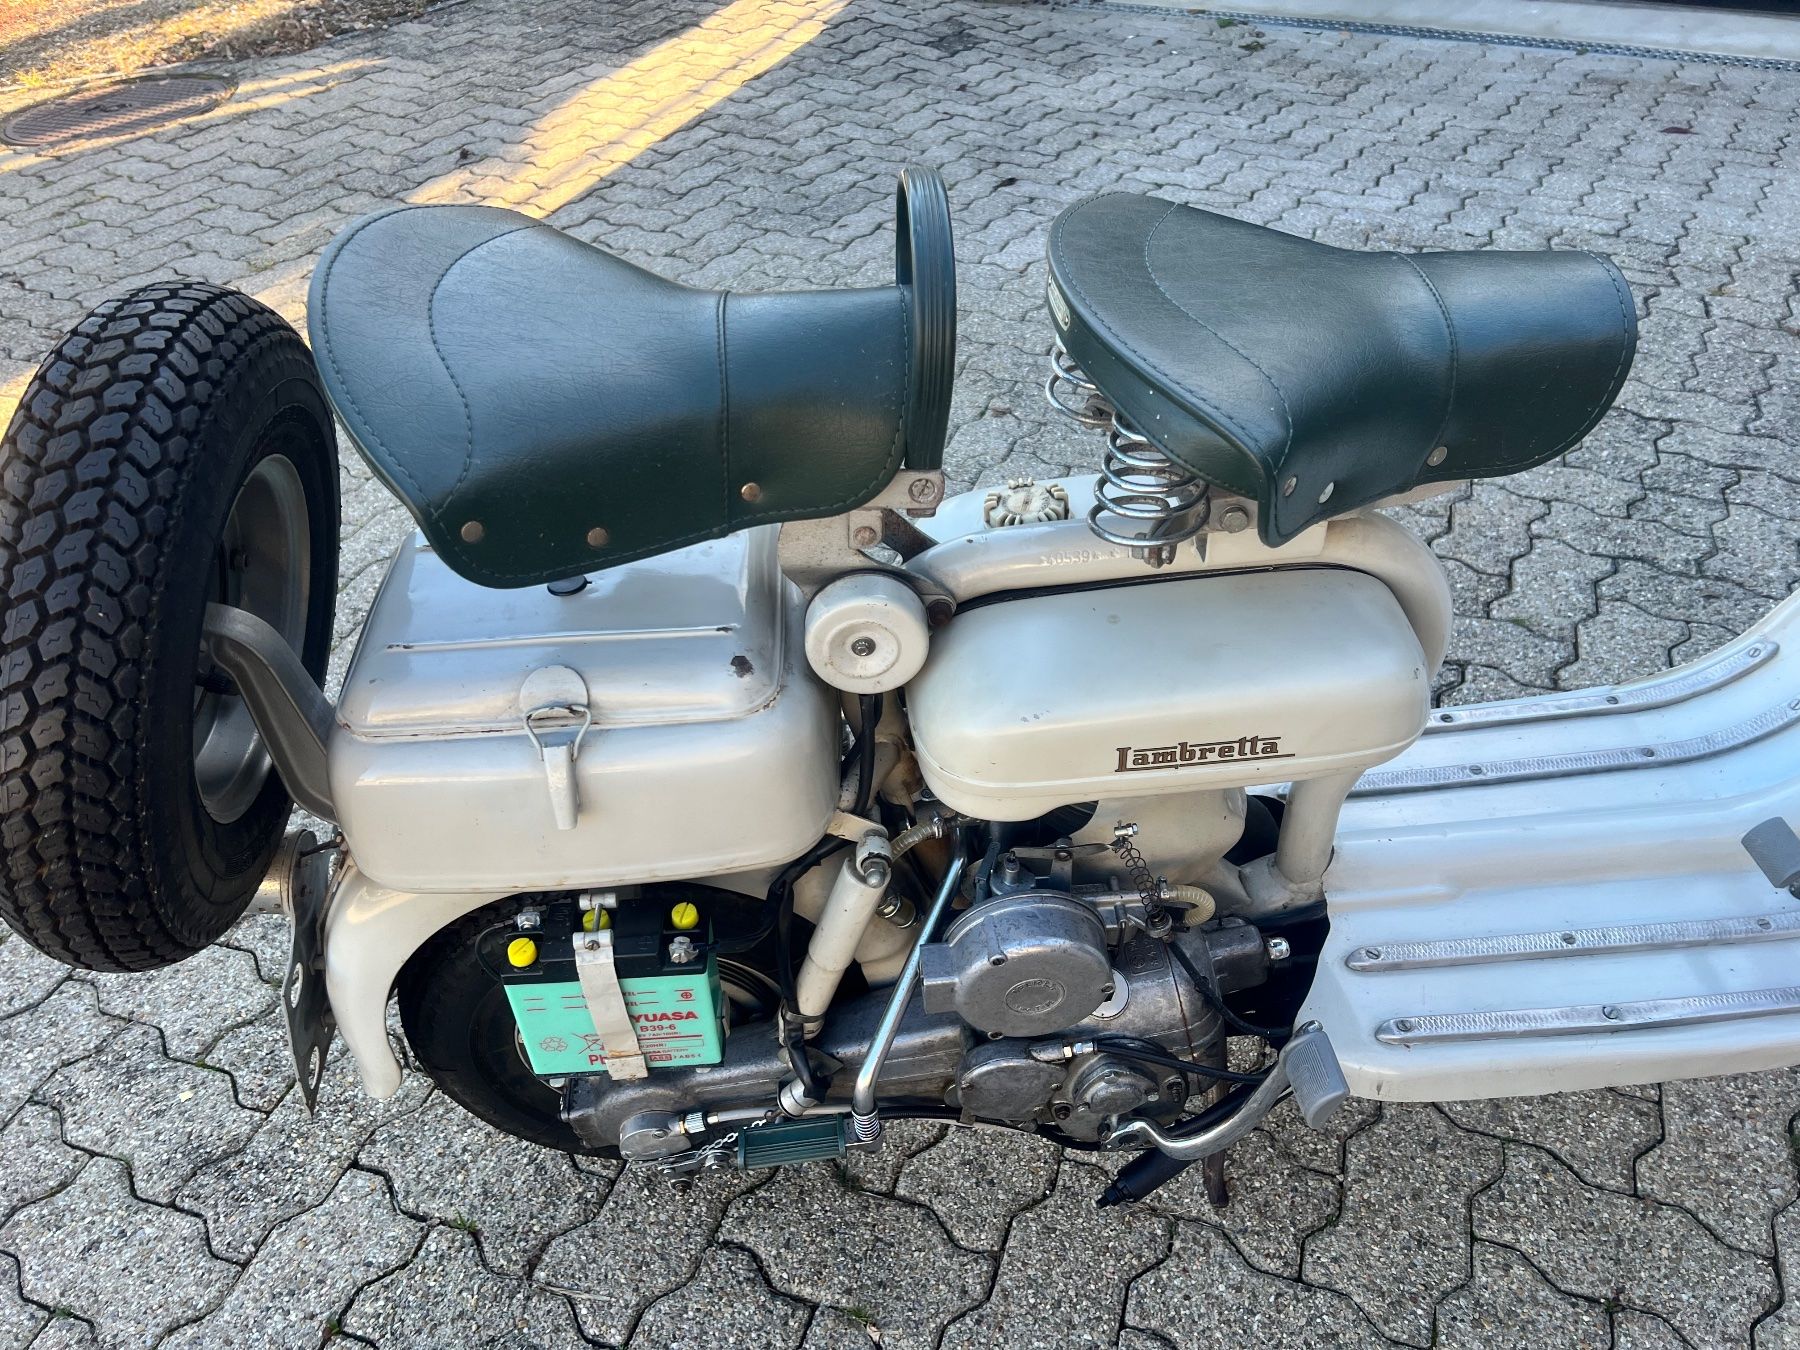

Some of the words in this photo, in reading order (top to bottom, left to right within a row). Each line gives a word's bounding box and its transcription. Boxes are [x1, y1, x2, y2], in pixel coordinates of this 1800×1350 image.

[1115, 736, 1295, 772] Lambretta
[630, 1011, 698, 1023] YUASA
[640, 1024, 676, 1033] B39-6
